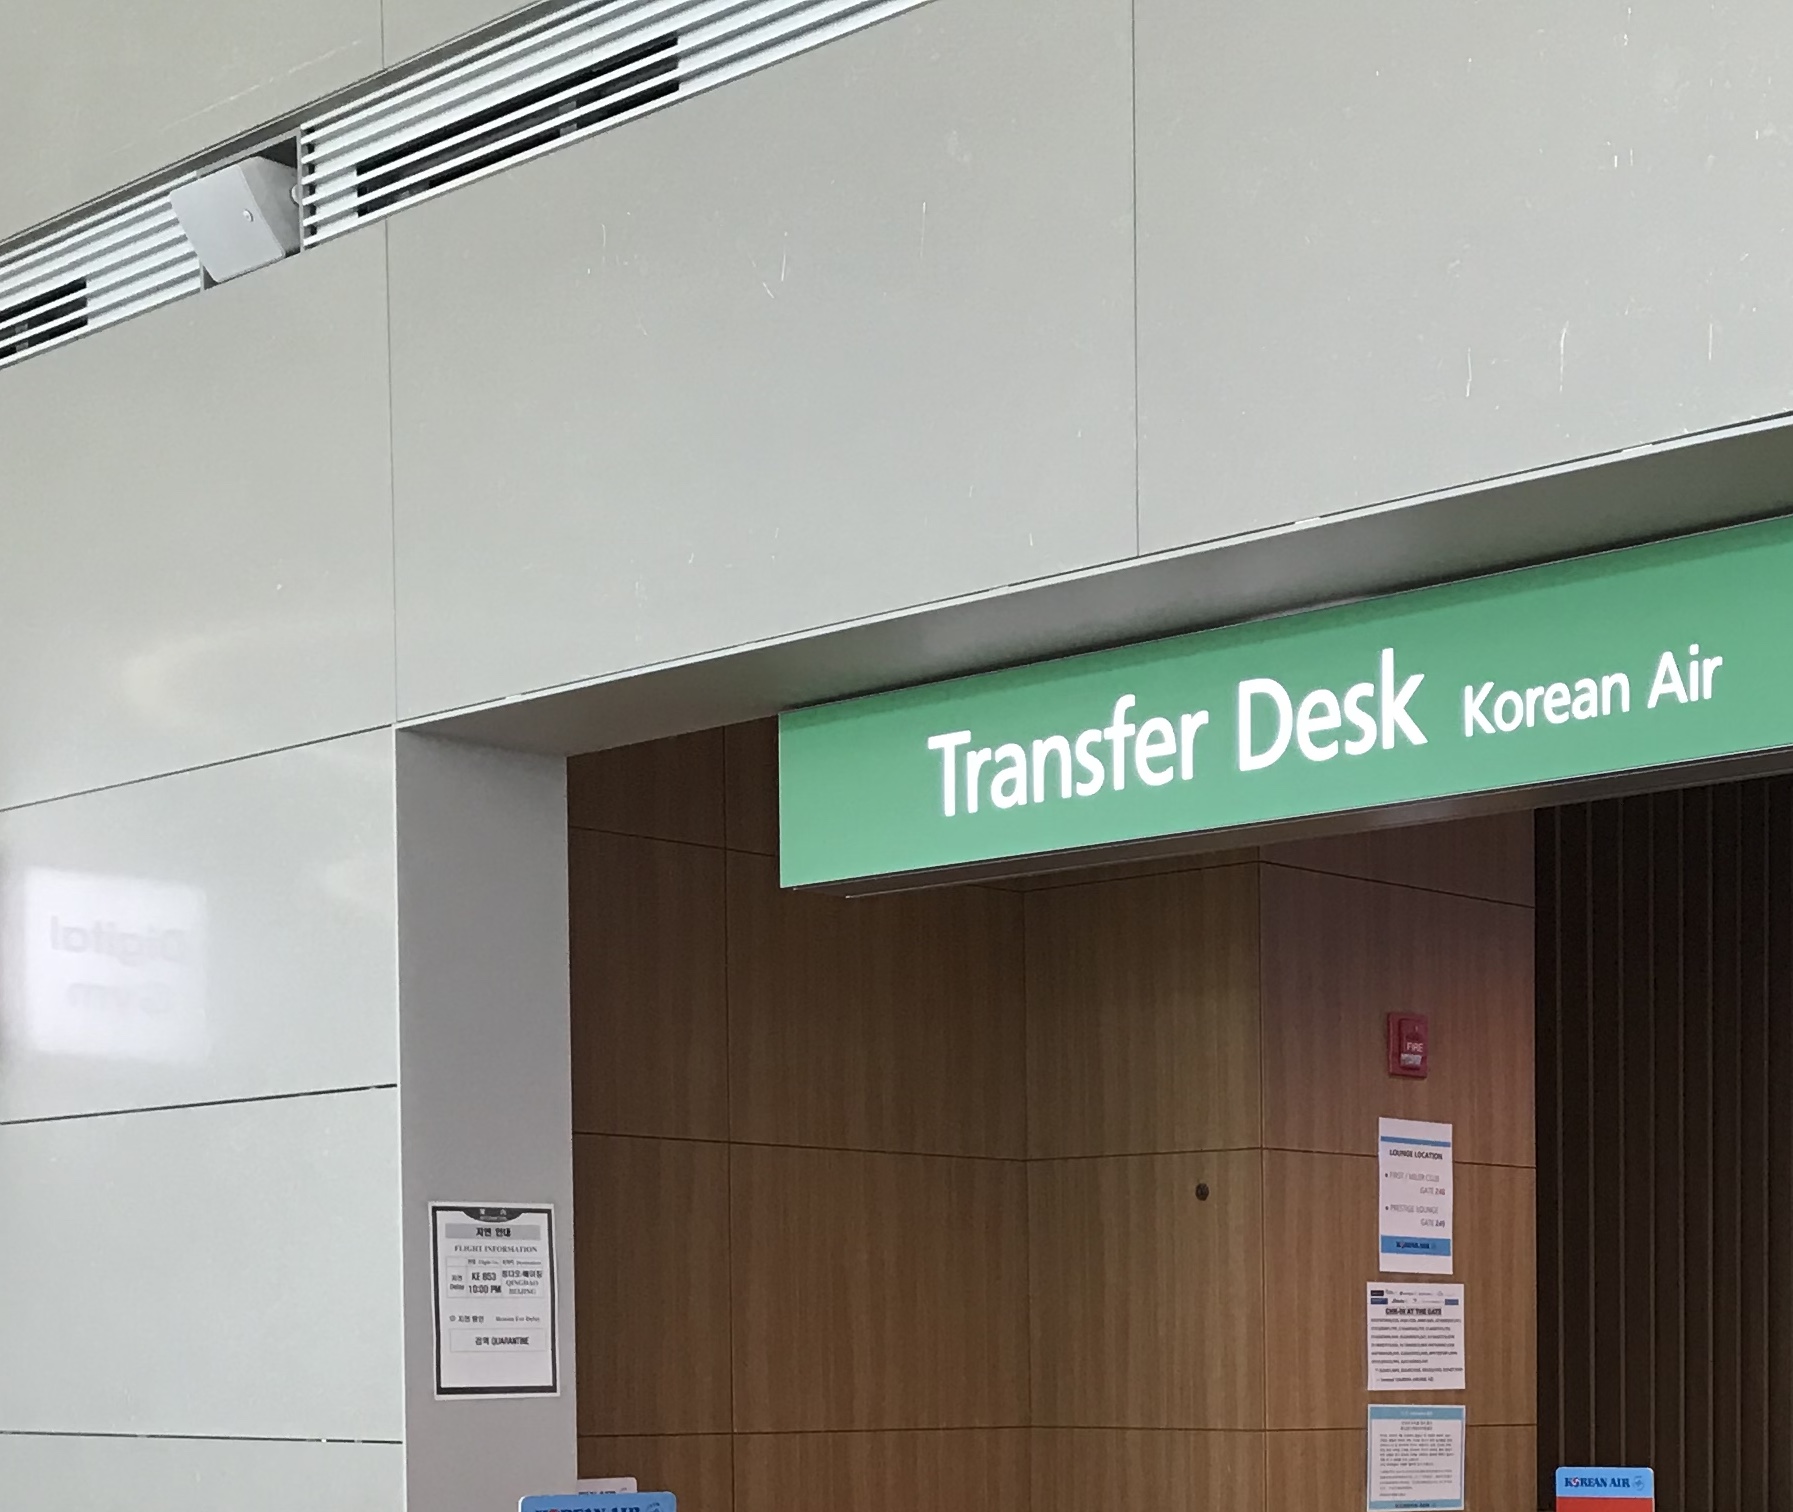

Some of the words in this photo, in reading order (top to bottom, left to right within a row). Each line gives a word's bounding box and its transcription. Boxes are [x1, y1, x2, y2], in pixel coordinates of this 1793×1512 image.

[927, 694, 1208, 817] Transfer
[1238, 647, 1427, 772] Desk
[1463, 671, 1630, 739] Korean
[1647, 643, 1722, 706] Air
[1406, 1042, 1423, 1052] FIRE
[1564, 1477, 1607, 1488] KOREAN
[1609, 1477, 1631, 1488] AIR
